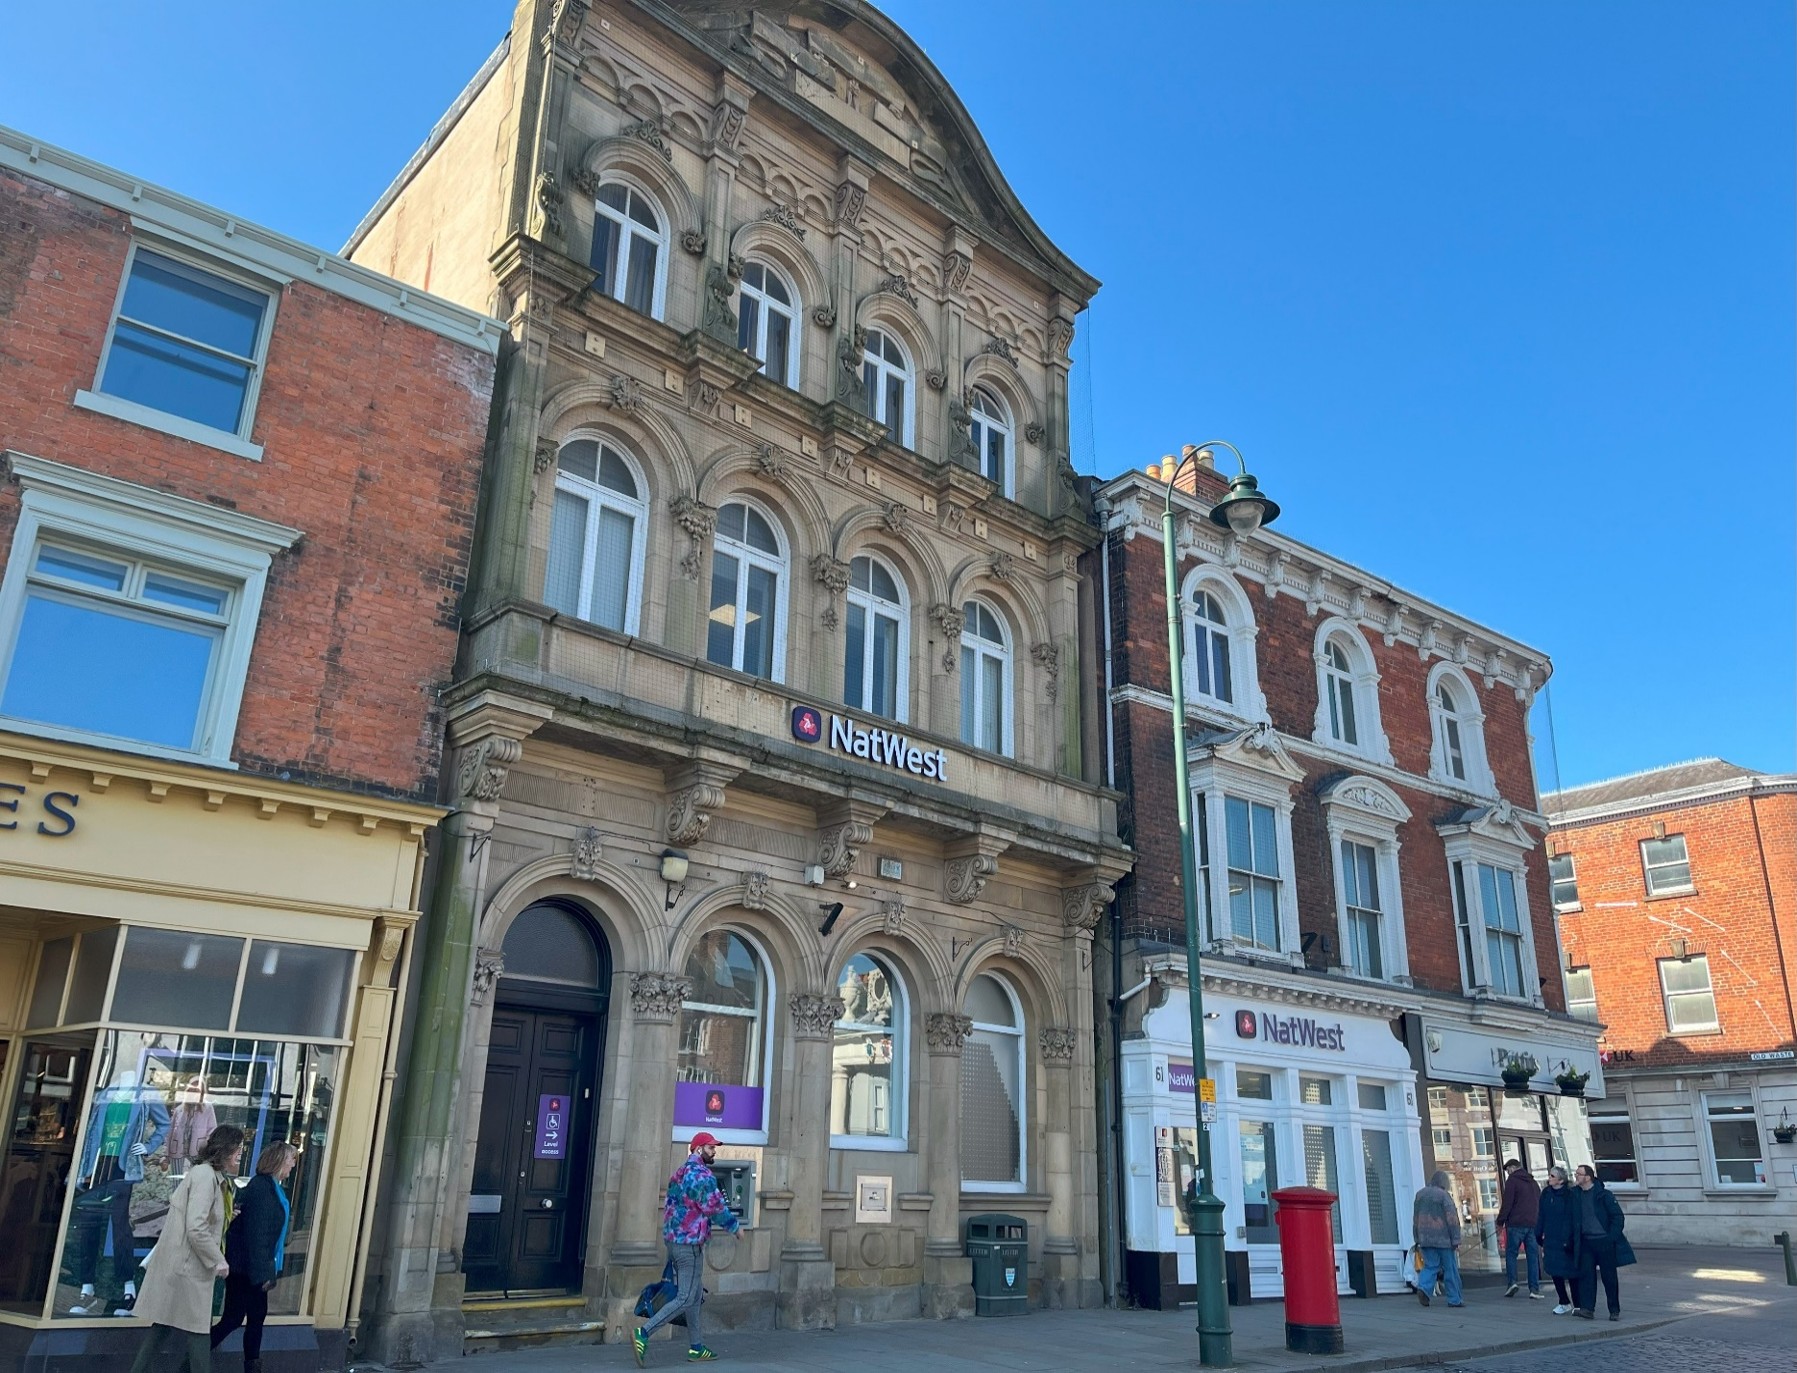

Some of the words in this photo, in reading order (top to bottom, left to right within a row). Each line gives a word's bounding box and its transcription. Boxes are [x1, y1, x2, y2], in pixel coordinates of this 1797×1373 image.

[829, 714, 948, 782] NatWest
[1262, 1012, 1346, 1052] NatWest
[1613, 1049, 1637, 1062] UK
[1769, 1051, 1793, 1059] WASTE
[1155, 1066, 1164, 1083] 61
[705, 1116, 723, 1124] NatWest
[1203, 1122, 1209, 1130] 2
[543, 1140, 559, 1148] Level
